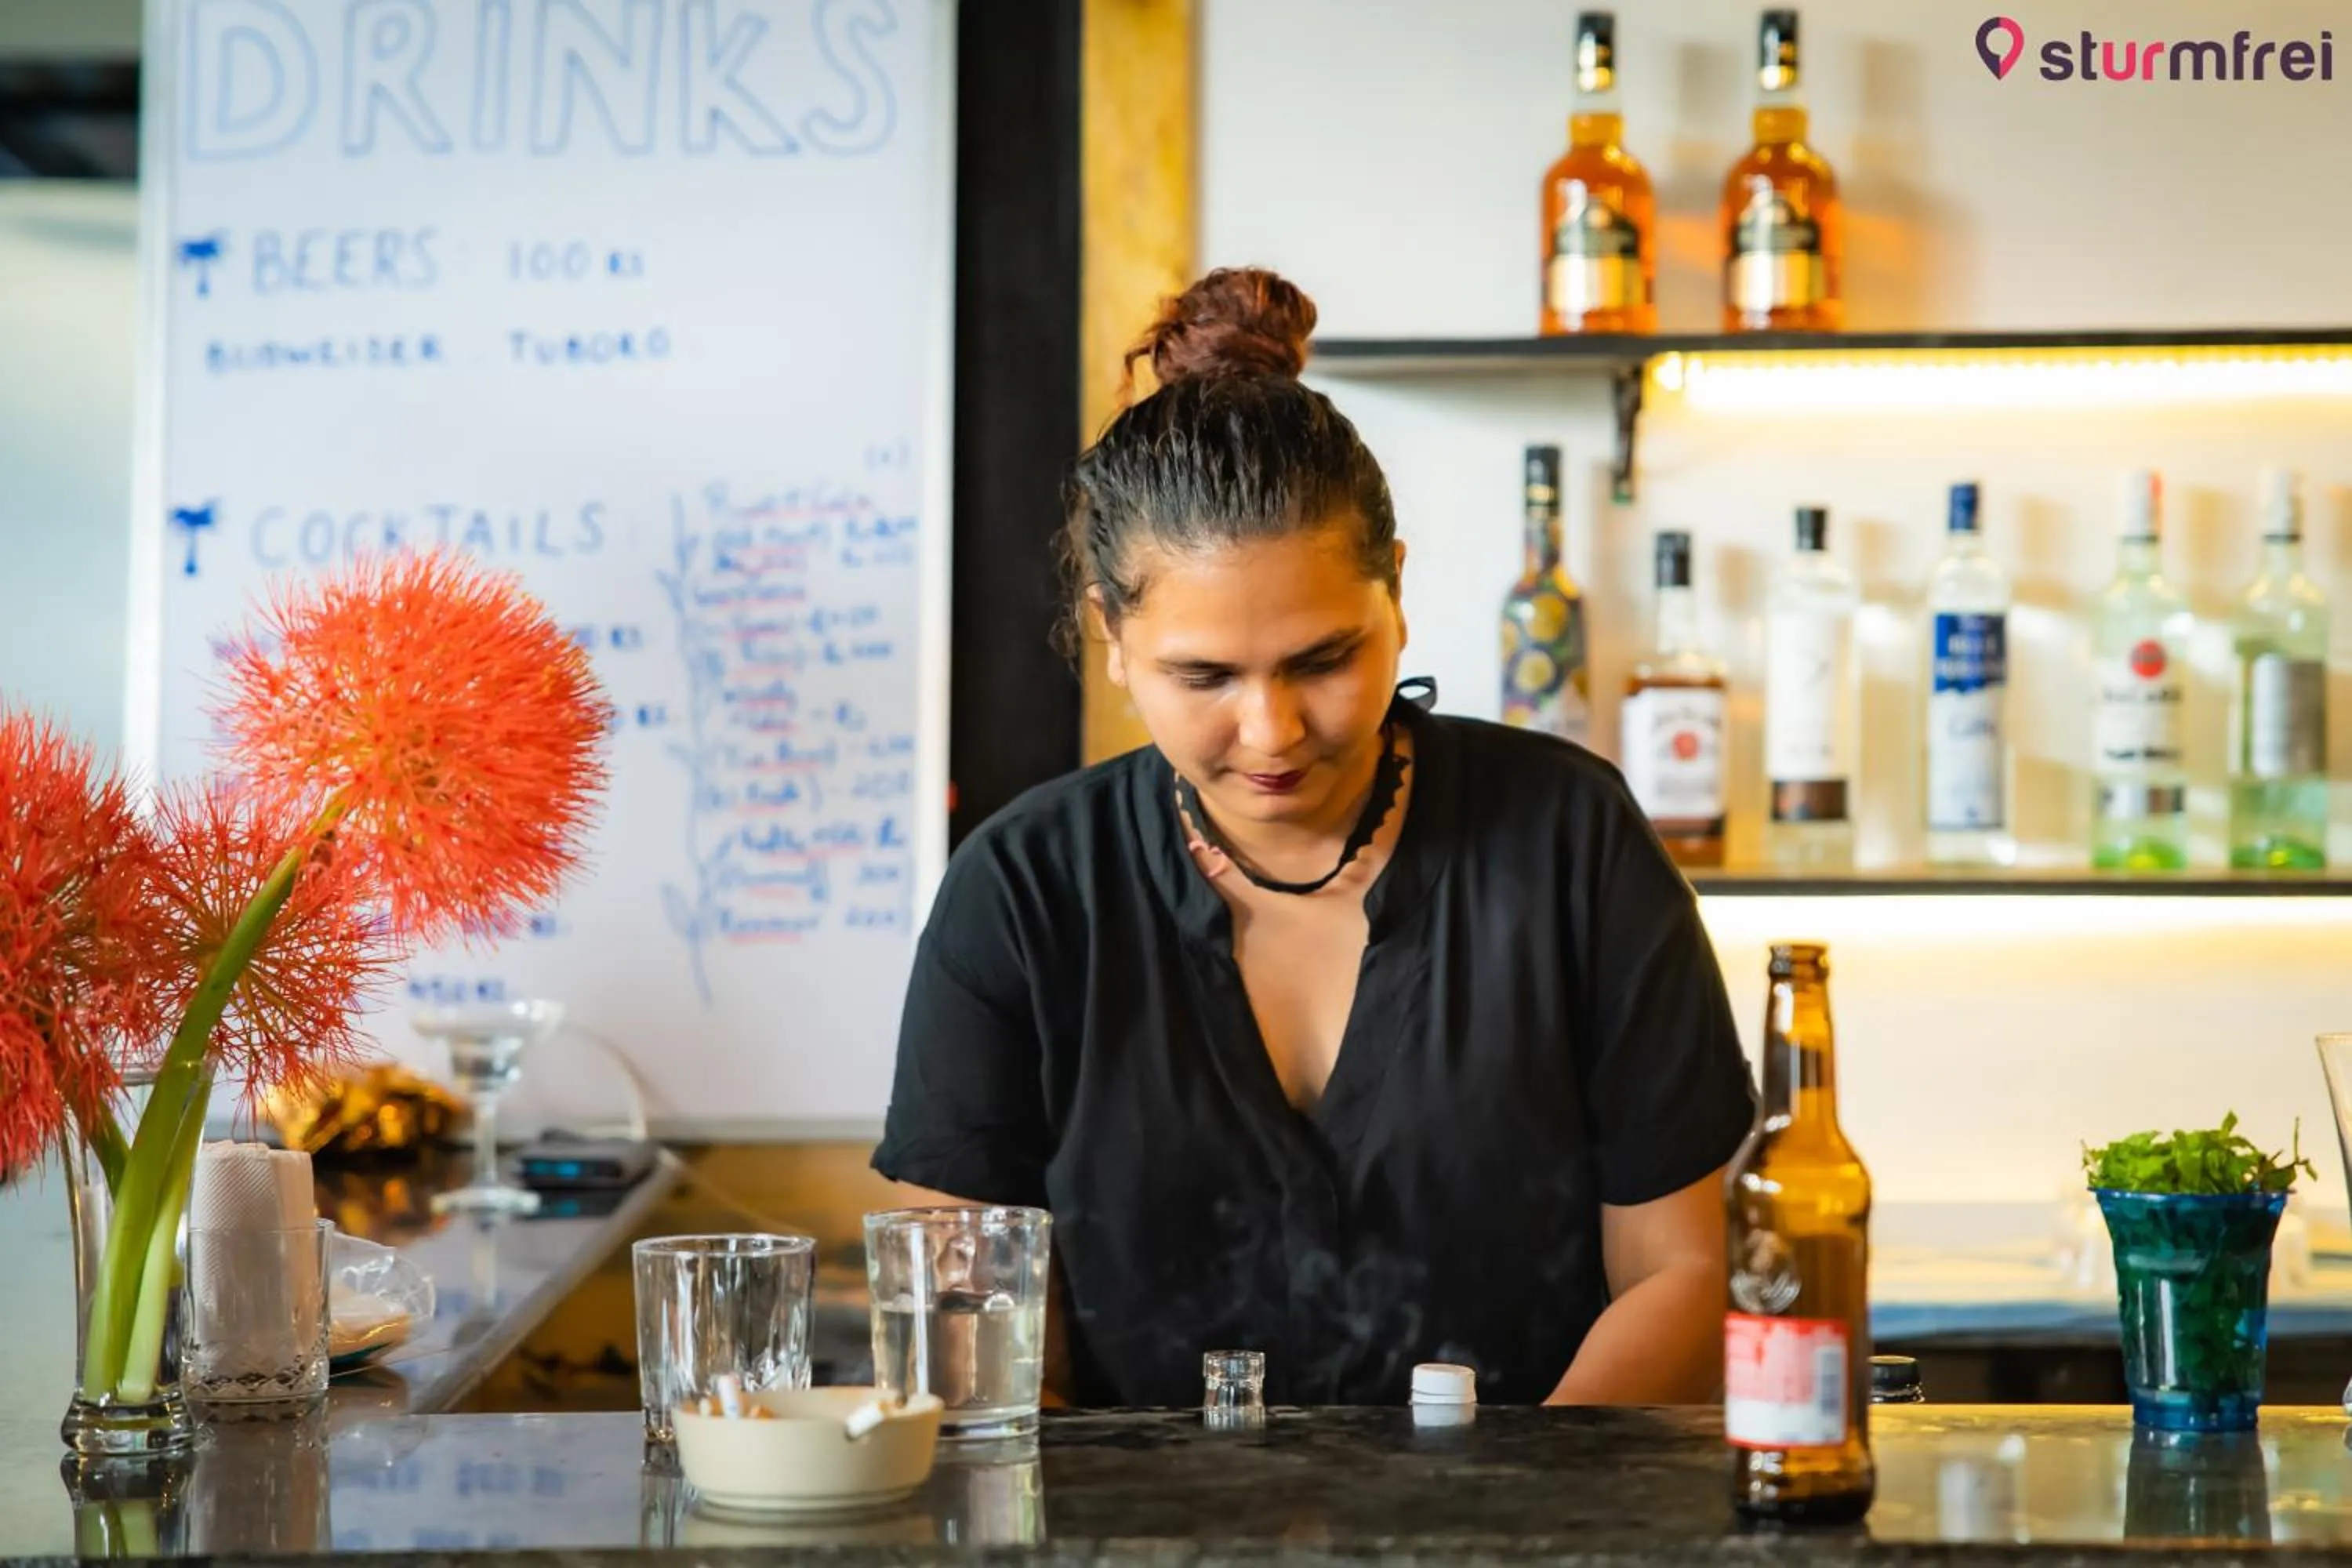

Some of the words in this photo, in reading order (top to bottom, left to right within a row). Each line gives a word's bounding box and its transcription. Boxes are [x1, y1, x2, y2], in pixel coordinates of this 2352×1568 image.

[183, 0, 900, 158] DRINKS
[252, 227, 439, 296] BEERS
[508, 239, 591, 281] 100
